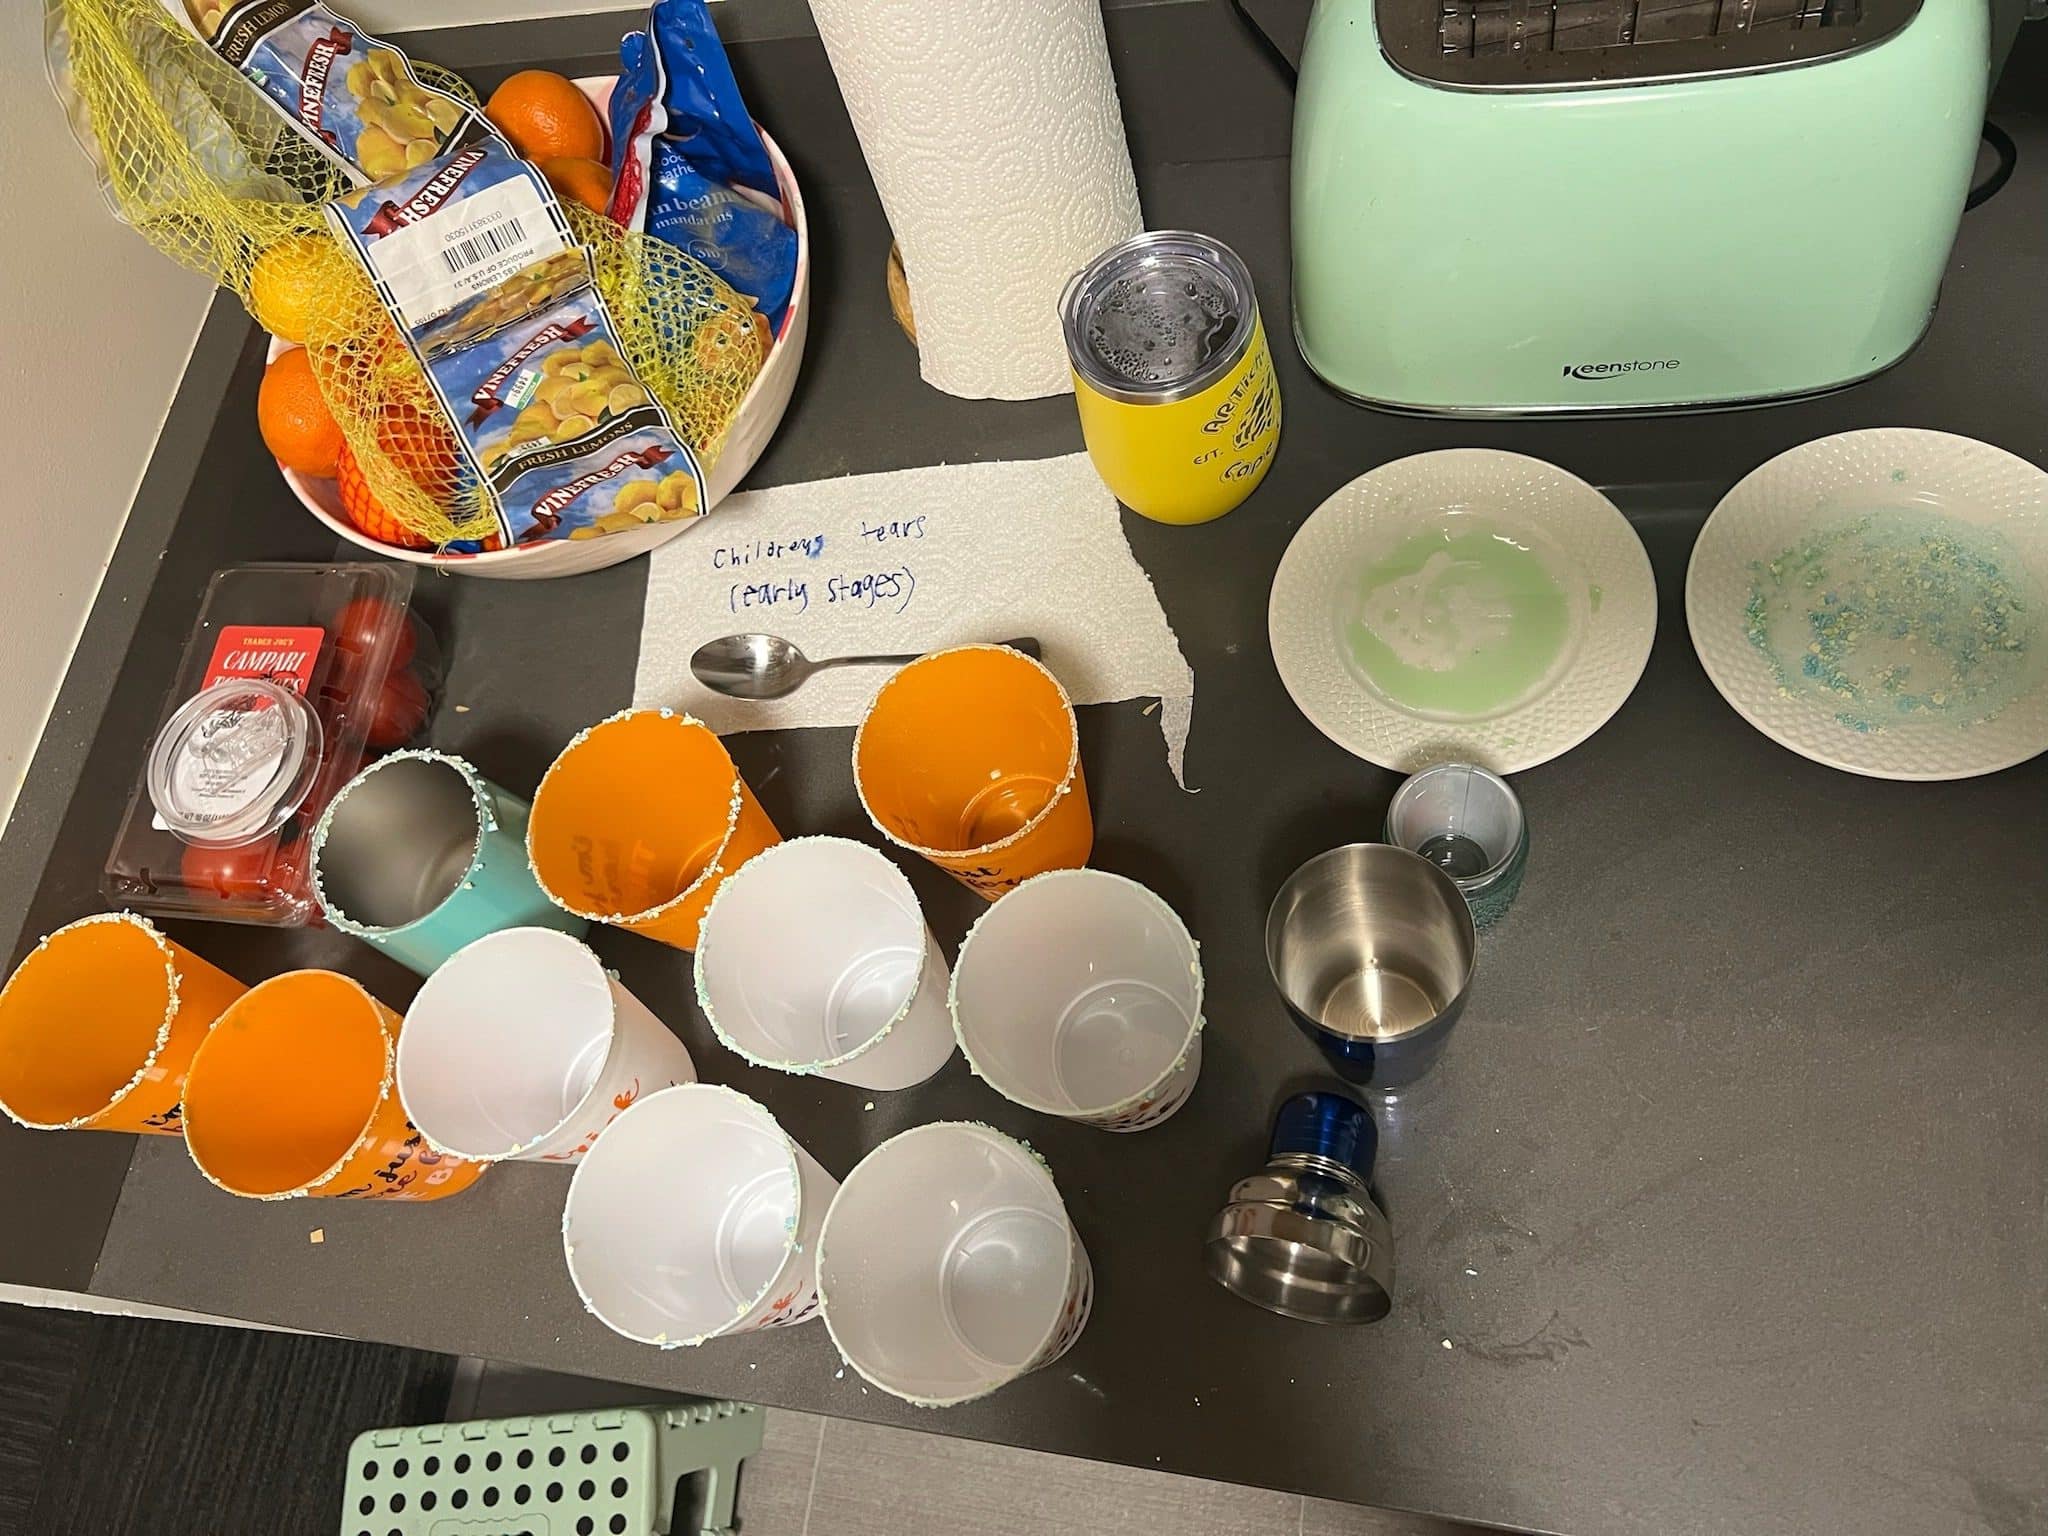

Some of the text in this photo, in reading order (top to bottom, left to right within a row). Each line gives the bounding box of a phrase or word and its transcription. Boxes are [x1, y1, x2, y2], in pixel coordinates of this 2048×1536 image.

[225, 20, 257, 63] FRESH
[400, 149, 487, 225] VINEFRESH
[474, 324, 565, 402] VINEFRESH
[1563, 359, 1681, 380] Keenstone
[517, 448, 569, 472] FRESH
[571, 421, 635, 455] LEMONS
[535, 451, 640, 518] VINEFRESH
[861, 515, 927, 546] tears
[729, 578, 809, 616] (early
[222, 649, 308, 672] CAMPARI
